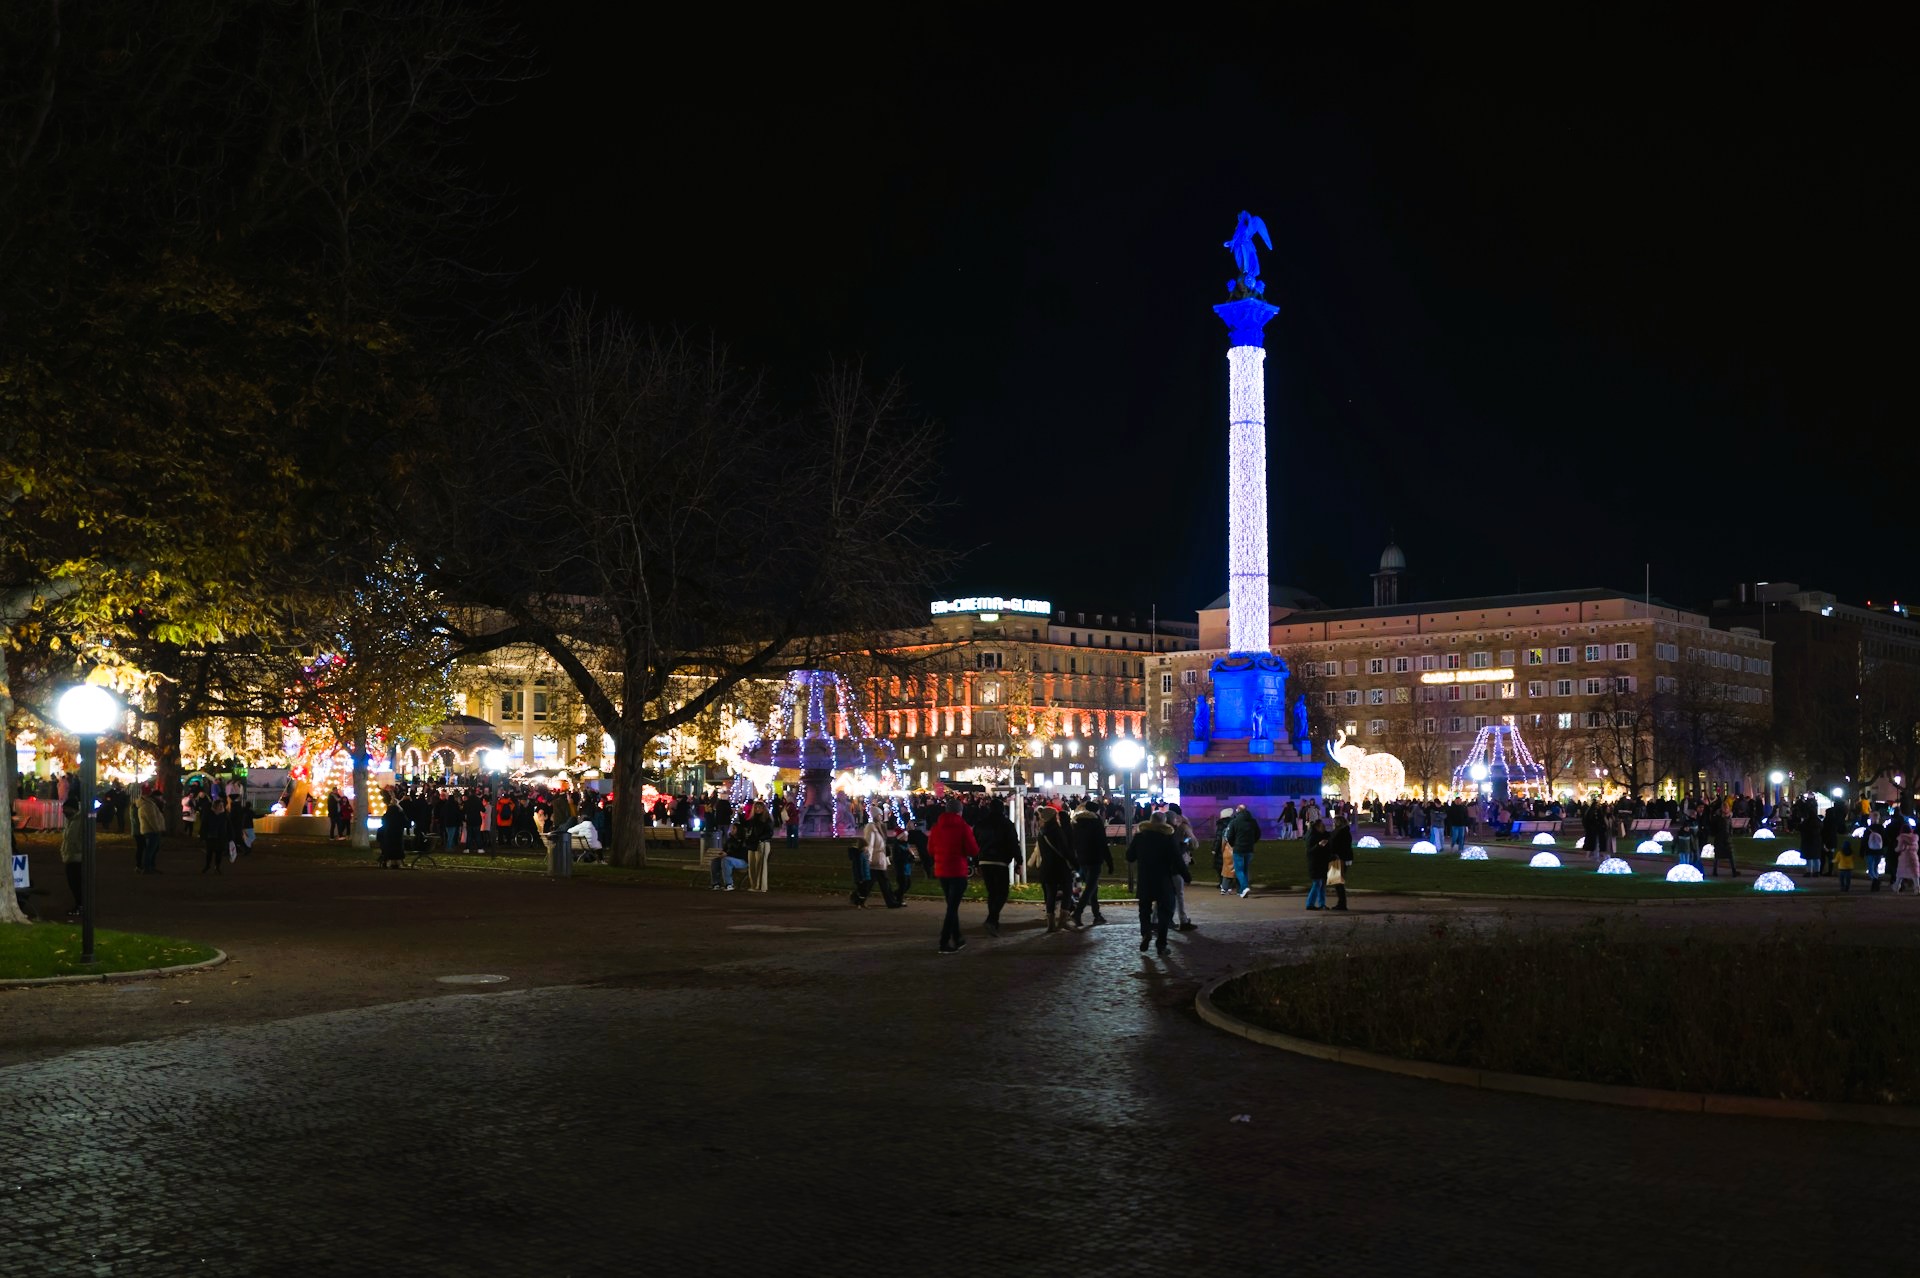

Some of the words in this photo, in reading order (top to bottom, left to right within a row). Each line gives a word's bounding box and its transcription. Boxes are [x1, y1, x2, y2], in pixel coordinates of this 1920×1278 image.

[953, 597, 1003, 611] CINEMA
[1010, 598, 1050, 613] GLORIA
[12, 856, 26, 871] N
